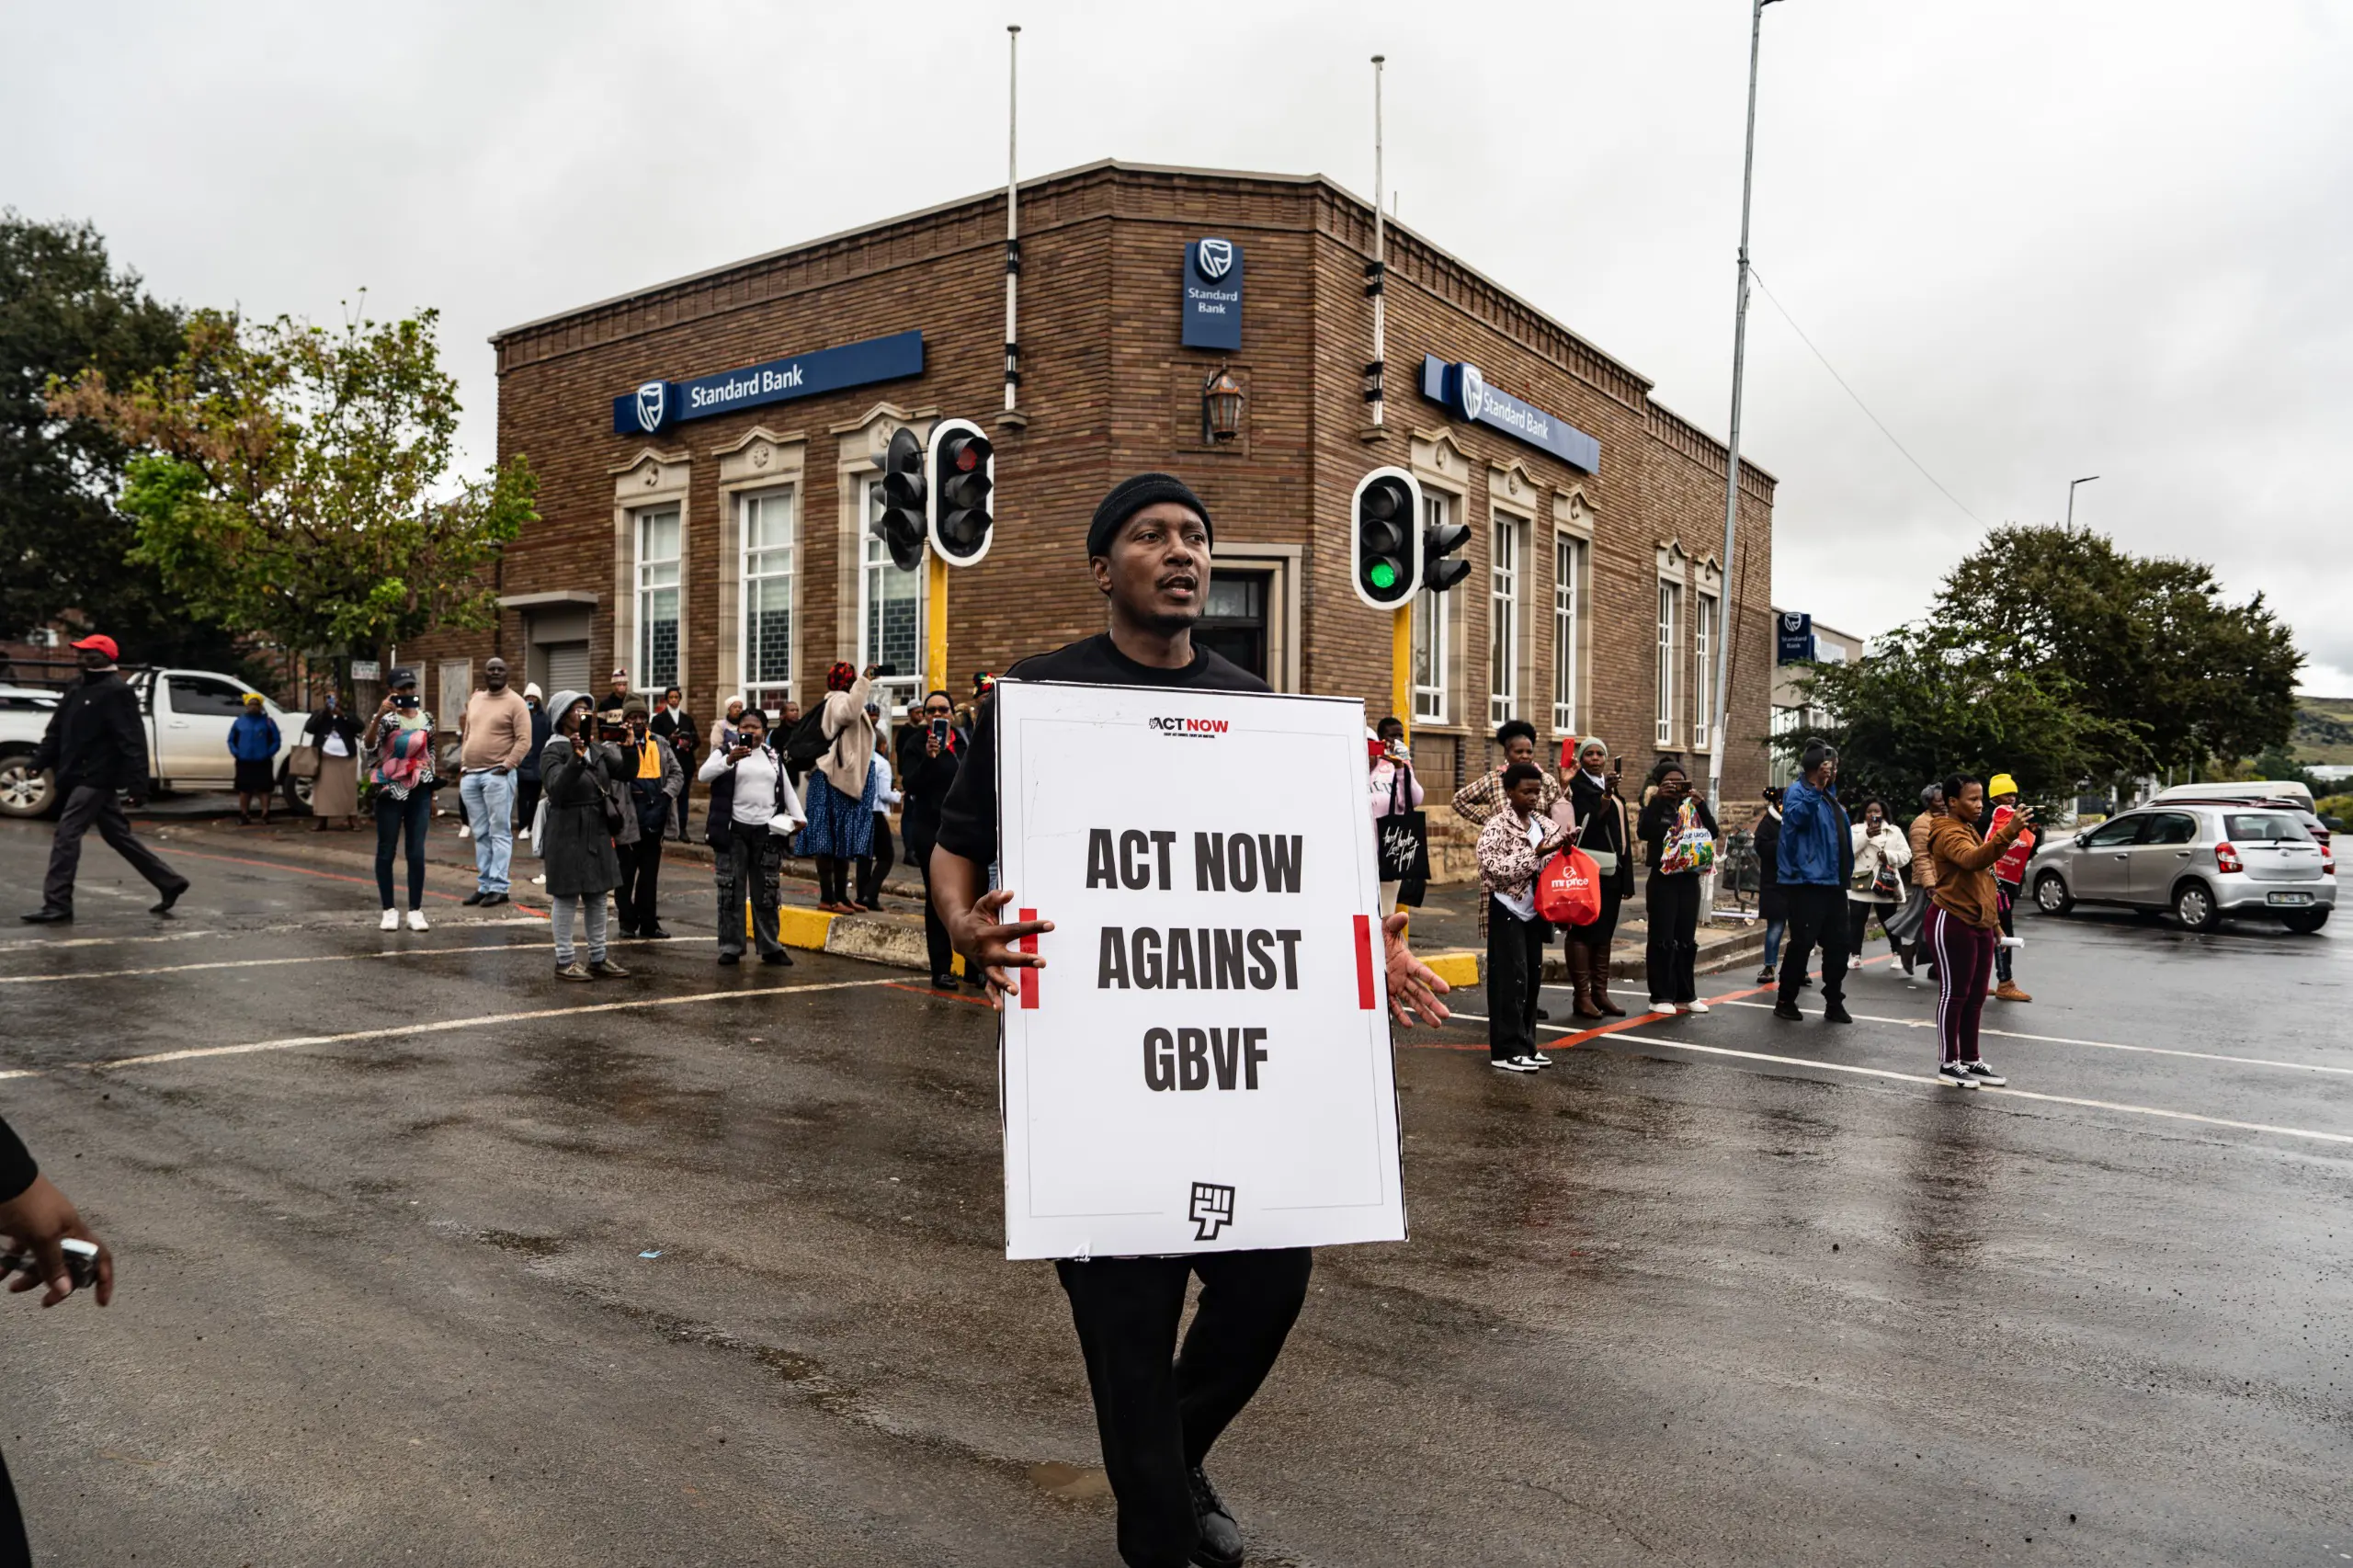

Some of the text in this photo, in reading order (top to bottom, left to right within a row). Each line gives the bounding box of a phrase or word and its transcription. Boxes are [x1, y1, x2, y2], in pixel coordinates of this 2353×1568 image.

[1188, 287, 1238, 301] Standard
[1198, 301, 1226, 314] Bank
[691, 364, 803, 408] Standard Bank
[1483, 392, 1549, 440] Standard Bank
[1149, 717, 1229, 733] ACT NOW
[1086, 829, 1302, 893] ACT NOW
[1552, 877, 1589, 889] mr price
[1097, 926, 1302, 991] AGAINST
[1143, 1028, 1268, 1092] GBVF
